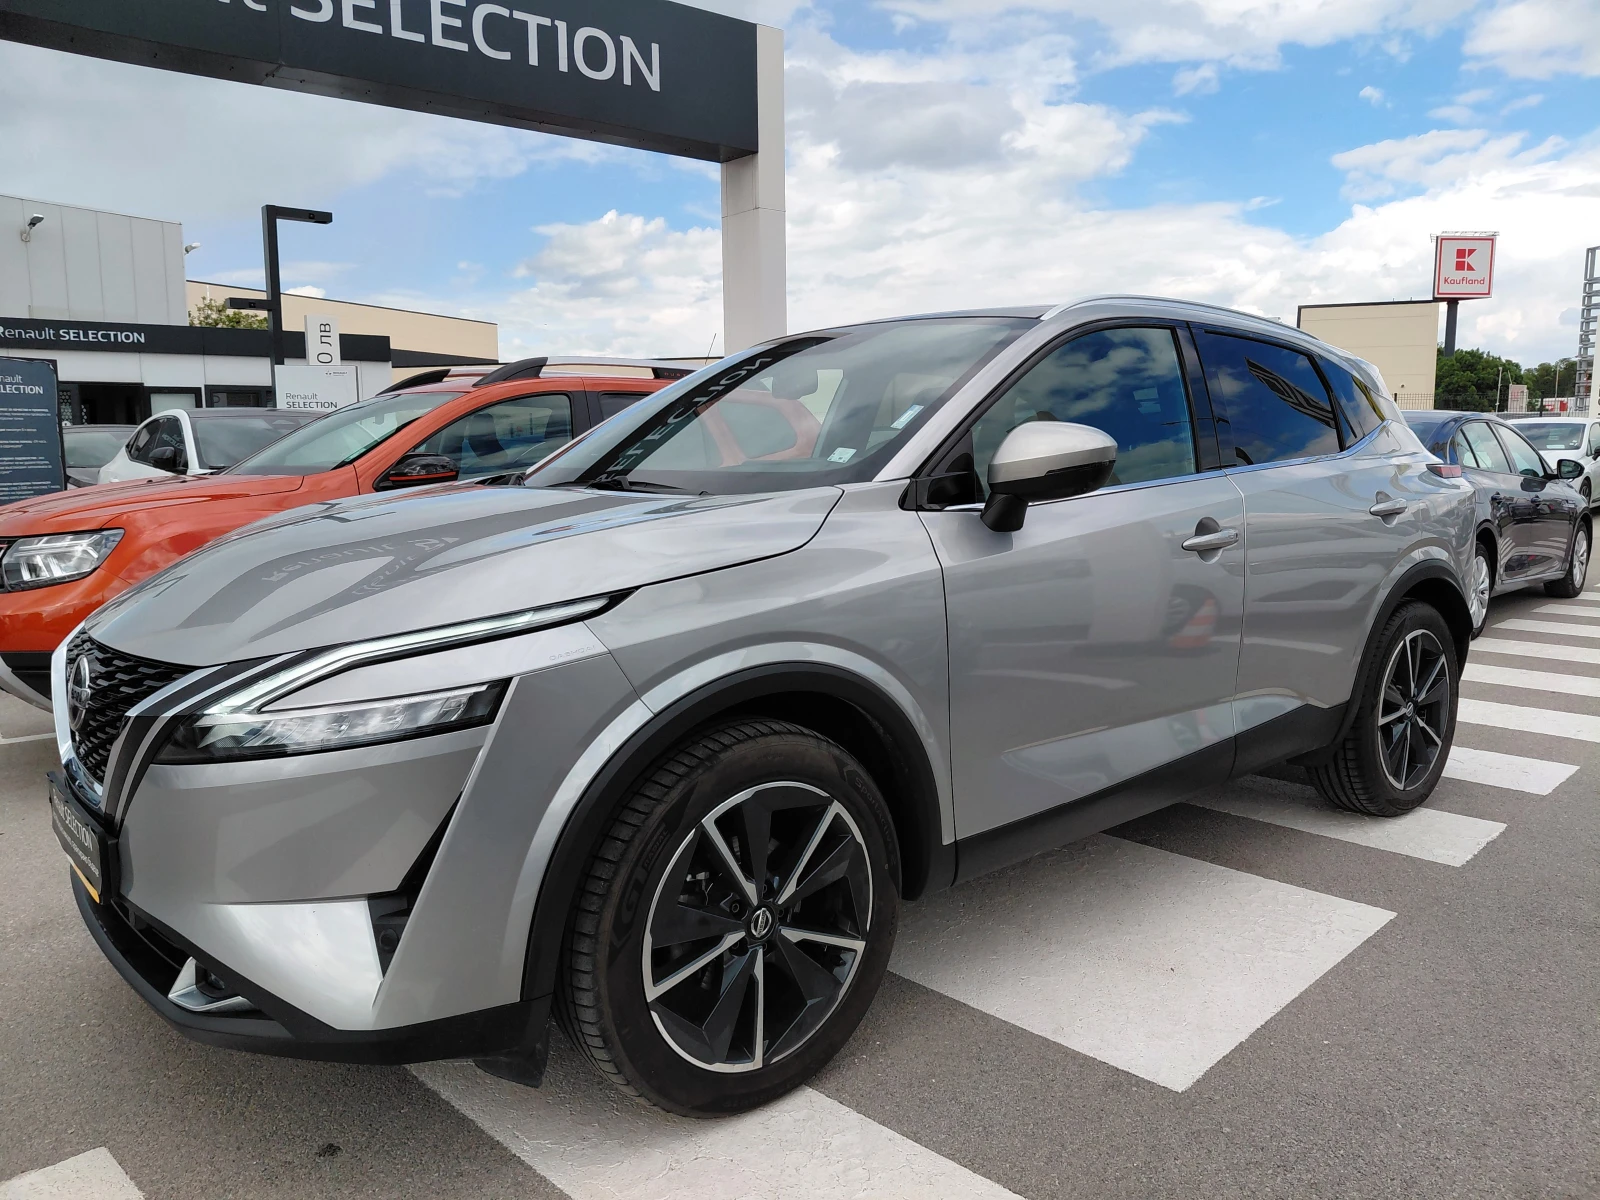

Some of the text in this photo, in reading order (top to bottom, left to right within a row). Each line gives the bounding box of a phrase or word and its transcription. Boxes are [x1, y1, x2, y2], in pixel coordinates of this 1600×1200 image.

[1443, 276, 1486, 285] Kaufland
[60, 329, 145, 343] SELECTION
[285, 392, 318, 400] Renault
[286, 401, 338, 409] SELECTION
